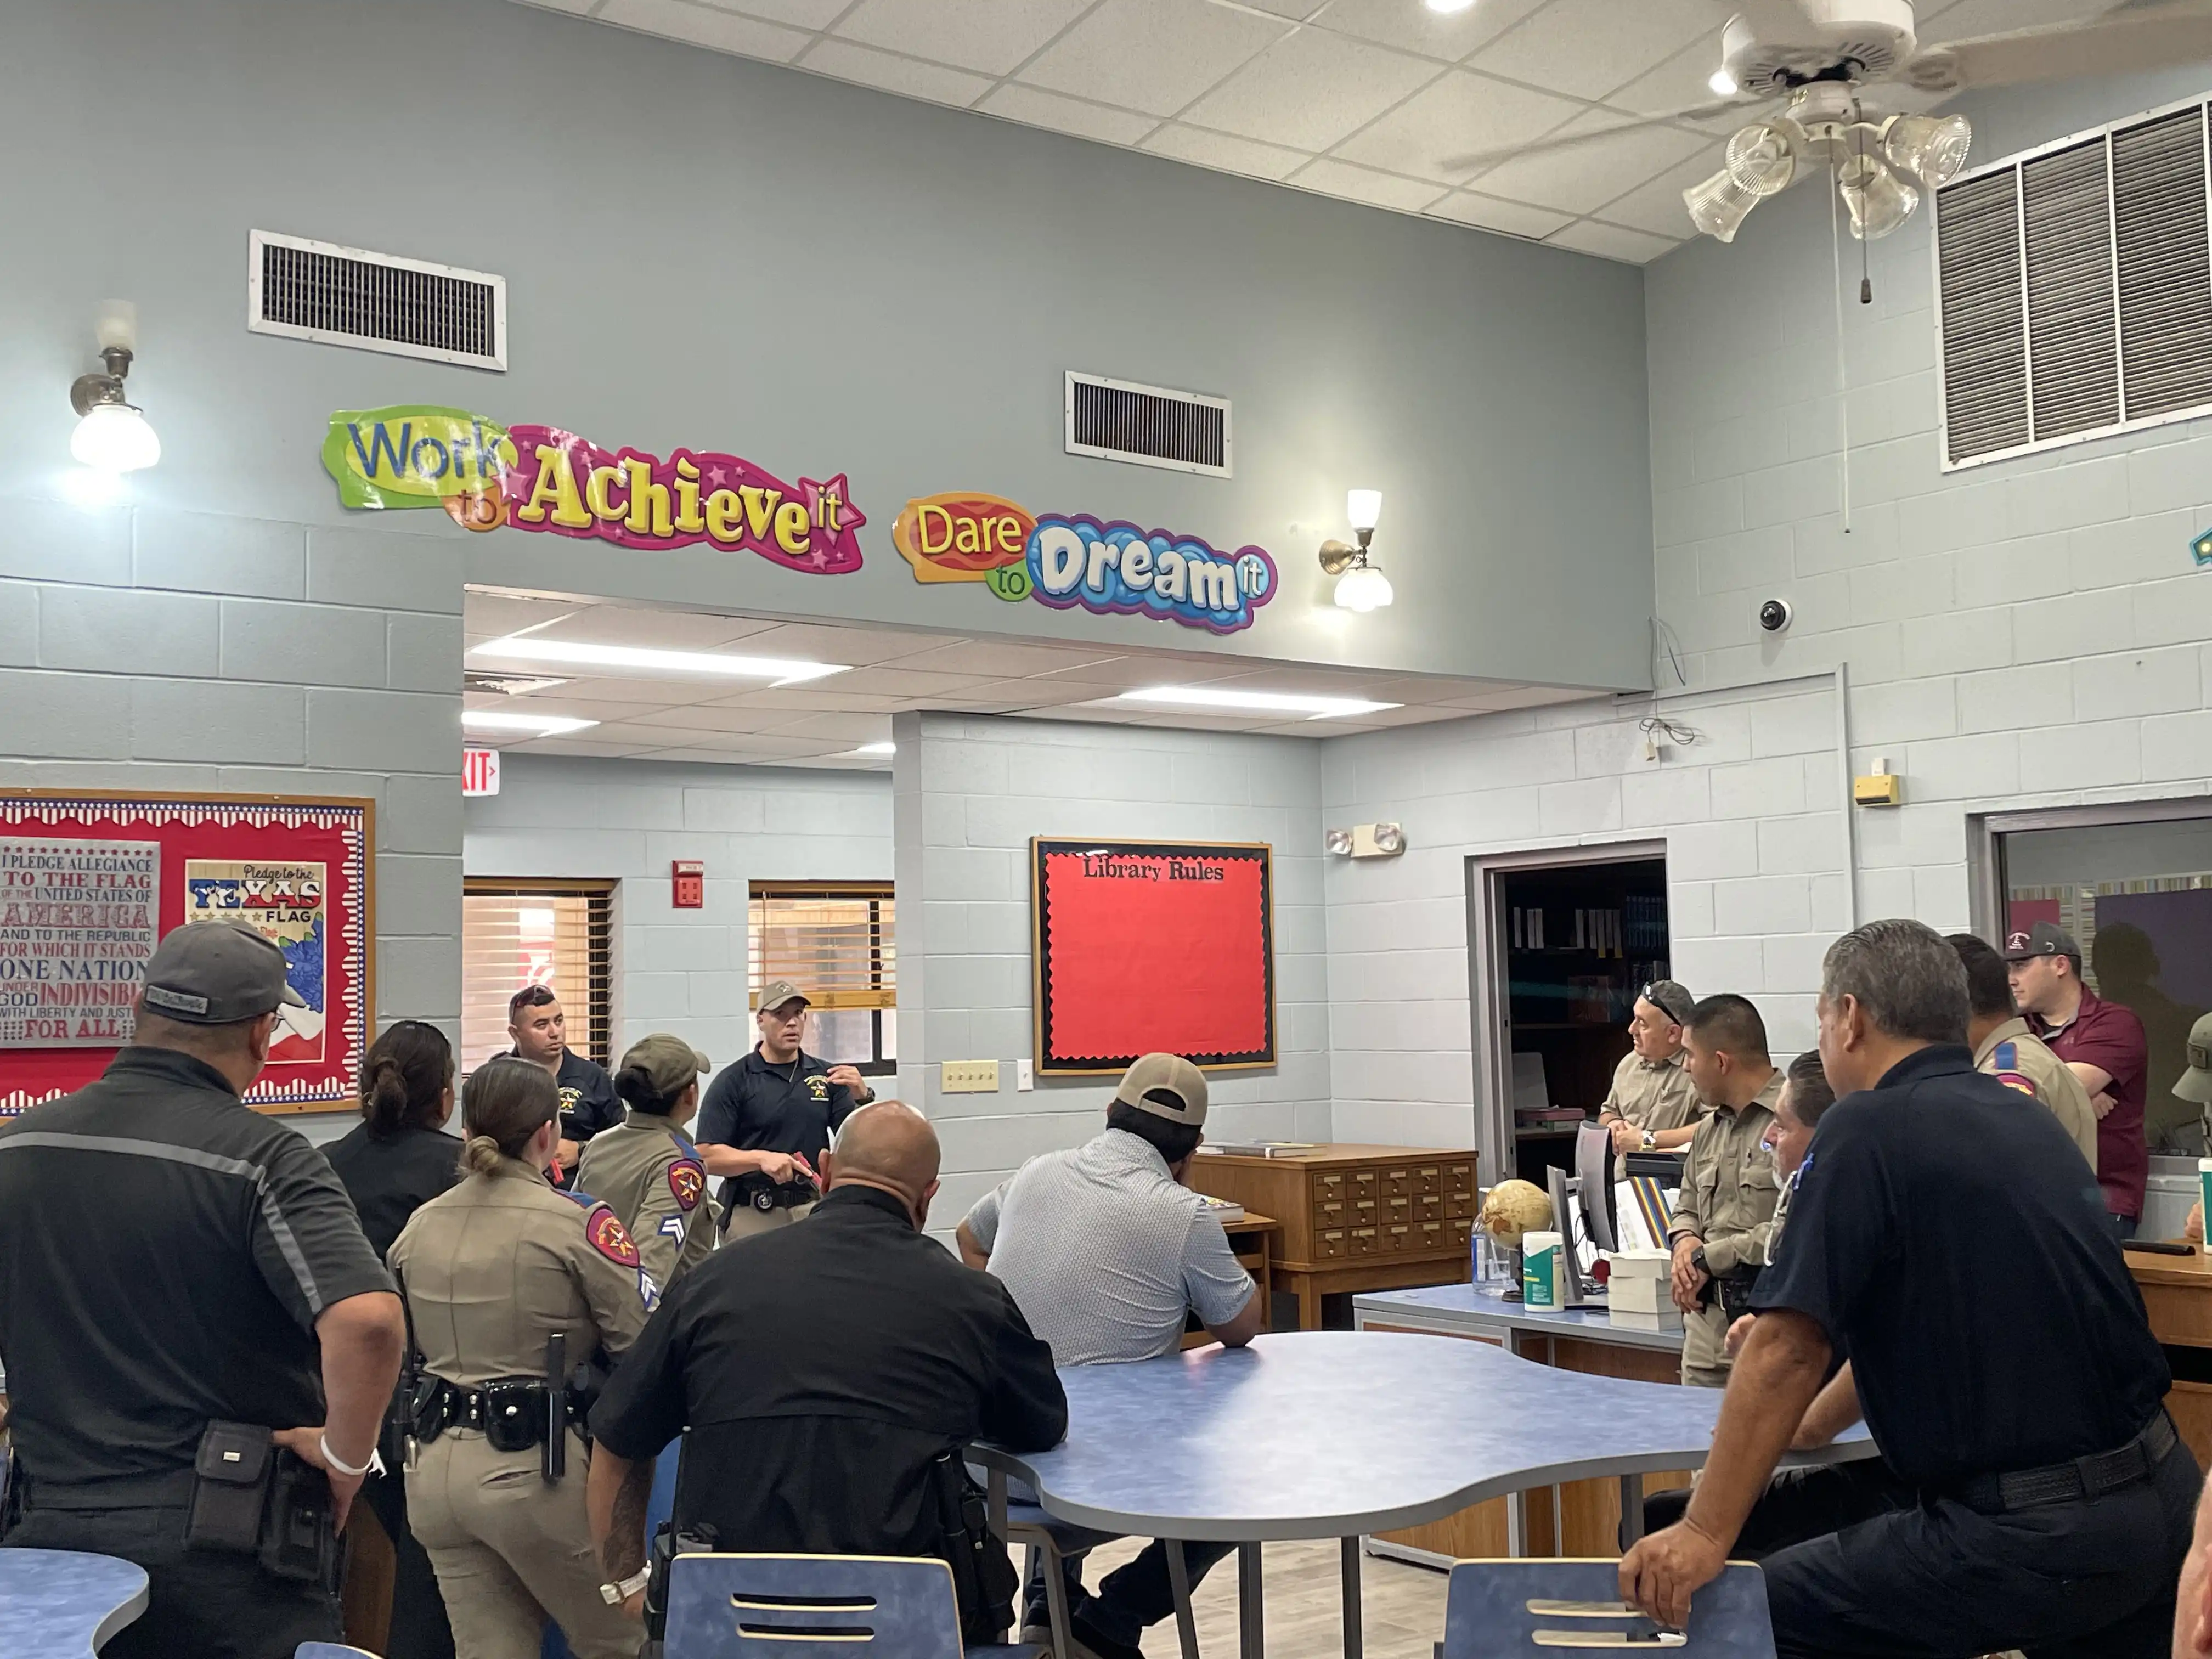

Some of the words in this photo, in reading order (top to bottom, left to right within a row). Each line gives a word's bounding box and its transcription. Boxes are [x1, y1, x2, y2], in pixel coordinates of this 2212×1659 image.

[347, 420, 506, 479] Work
[458, 489, 498, 524] to
[517, 443, 812, 555] Achieve
[816, 487, 843, 532] it
[918, 504, 1022, 555] Dare
[995, 563, 1025, 595] to
[1039, 526, 1240, 611] Dream
[1242, 556, 1263, 596] it
[3, 855, 6, 867] I
[11, 855, 64, 870] PLEDGE
[69, 857, 153, 872] ALLEGIANCE
[1083, 858, 1161, 882] Library
[1168, 861, 1224, 881] Rules
[3, 871, 35, 887] TO
[43, 872, 89, 888] THE
[96, 873, 151, 889] FLAG
[244, 865, 282, 884] Pledge
[283, 867, 295, 879] to
[295, 867, 314, 879] the
[2, 889, 14, 899] OF
[15, 889, 33, 899] THE
[35, 887, 82, 901] UNITED
[86, 888, 132, 902] STATES
[136, 889, 153, 903] OF
[189, 879, 321, 909] TEXAS
[1, 902, 151, 928] AMERICA
[266, 911, 311, 922] FLAG
[1, 929, 30, 940] AND
[35, 929, 52, 941] TO
[57, 930, 82, 941] THE
[87, 930, 151, 943] REPUBLIC
[0, 941, 27, 957] FOR
[32, 942, 79, 958] WHICH
[84, 943, 98, 958] IT
[100, 943, 150, 958] STANDS
[0, 958, 50, 980] ONE
[58, 960, 147, 981] NATION
[0, 992, 38, 1006] GOD
[0, 1007, 26, 1018] WITH
[30, 1007, 76, 1018] LIBERTY
[80, 1008, 103, 1018] AND
[24, 1019, 68, 1039] FOR
[76, 1019, 120, 1038] ALL
